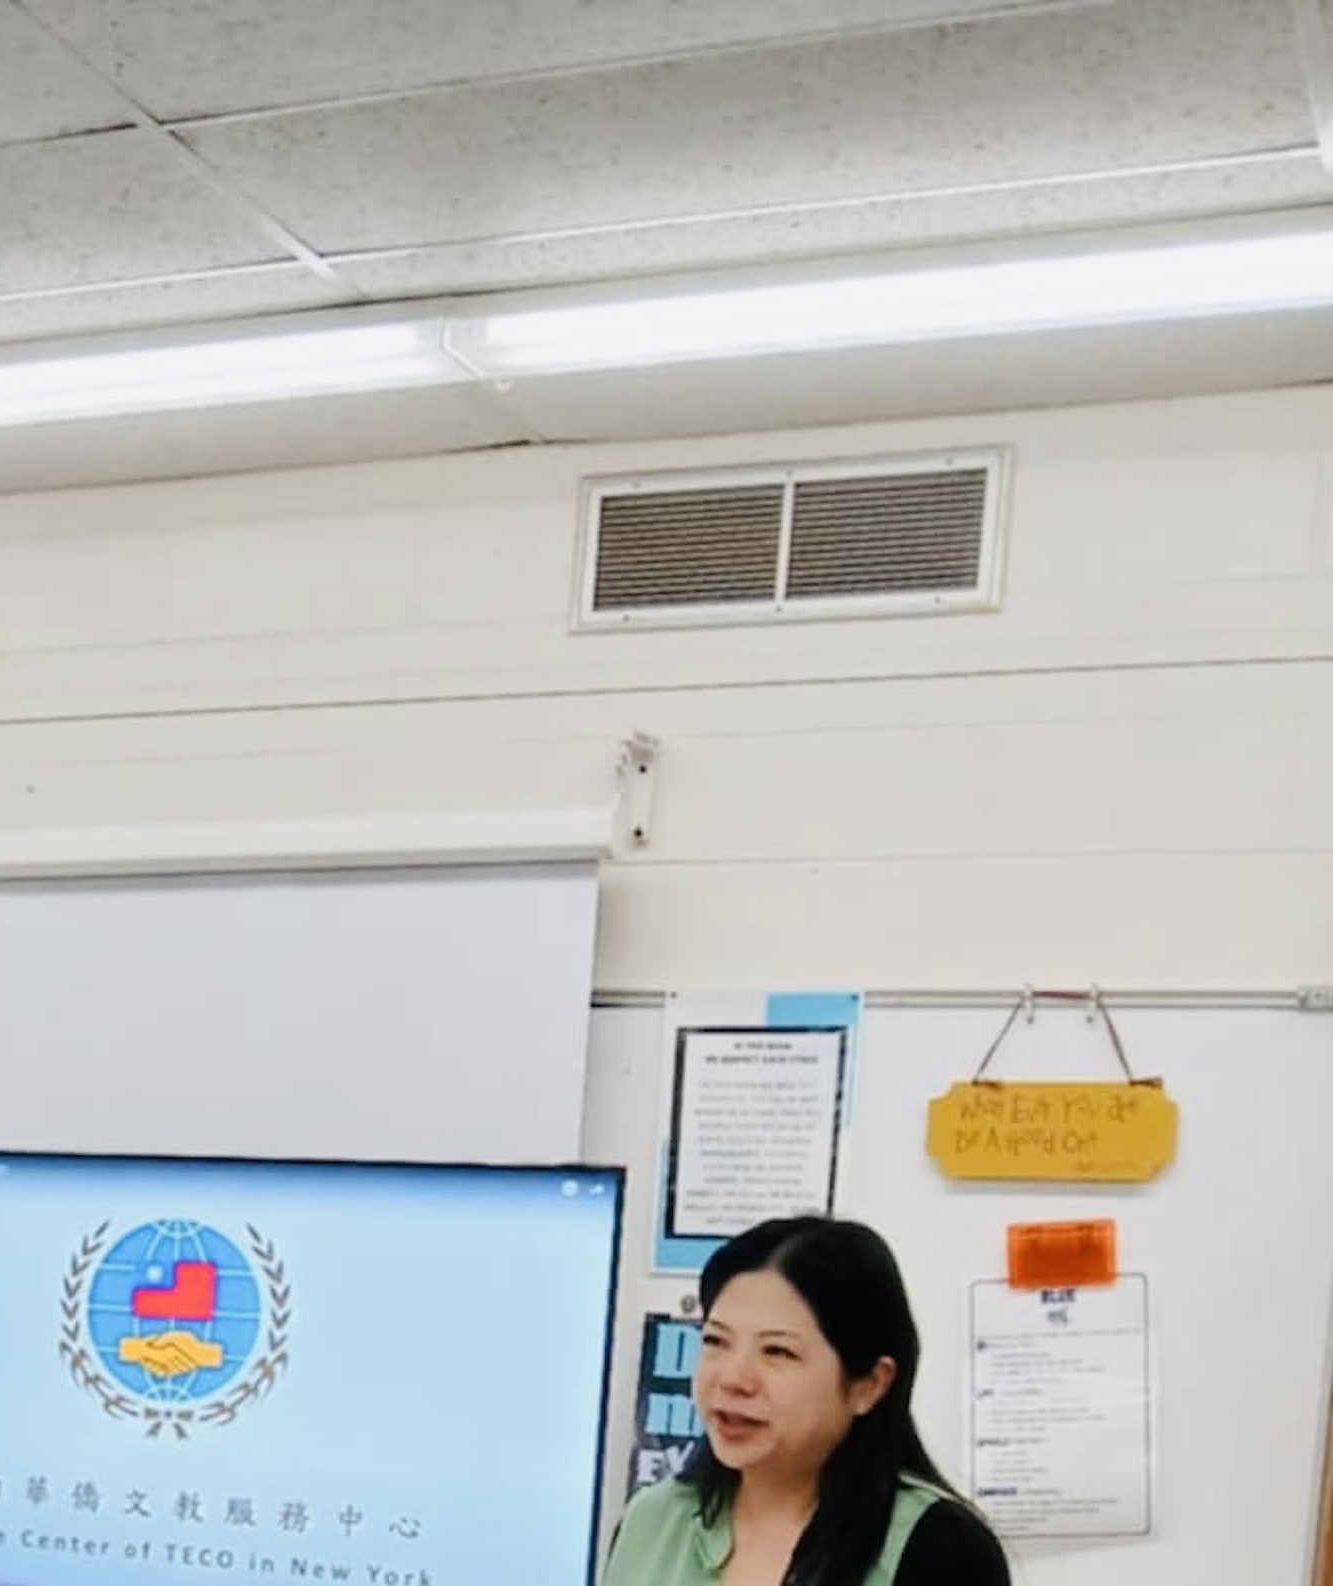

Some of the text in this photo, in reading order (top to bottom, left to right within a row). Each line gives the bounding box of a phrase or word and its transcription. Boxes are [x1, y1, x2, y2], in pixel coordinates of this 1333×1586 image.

[20, 1528, 110, 1555] Center
[124, 1541, 151, 1563] of
[165, 1544, 234, 1570] TECO
[249, 1554, 275, 1573] in
[290, 1558, 351, 1582] New
